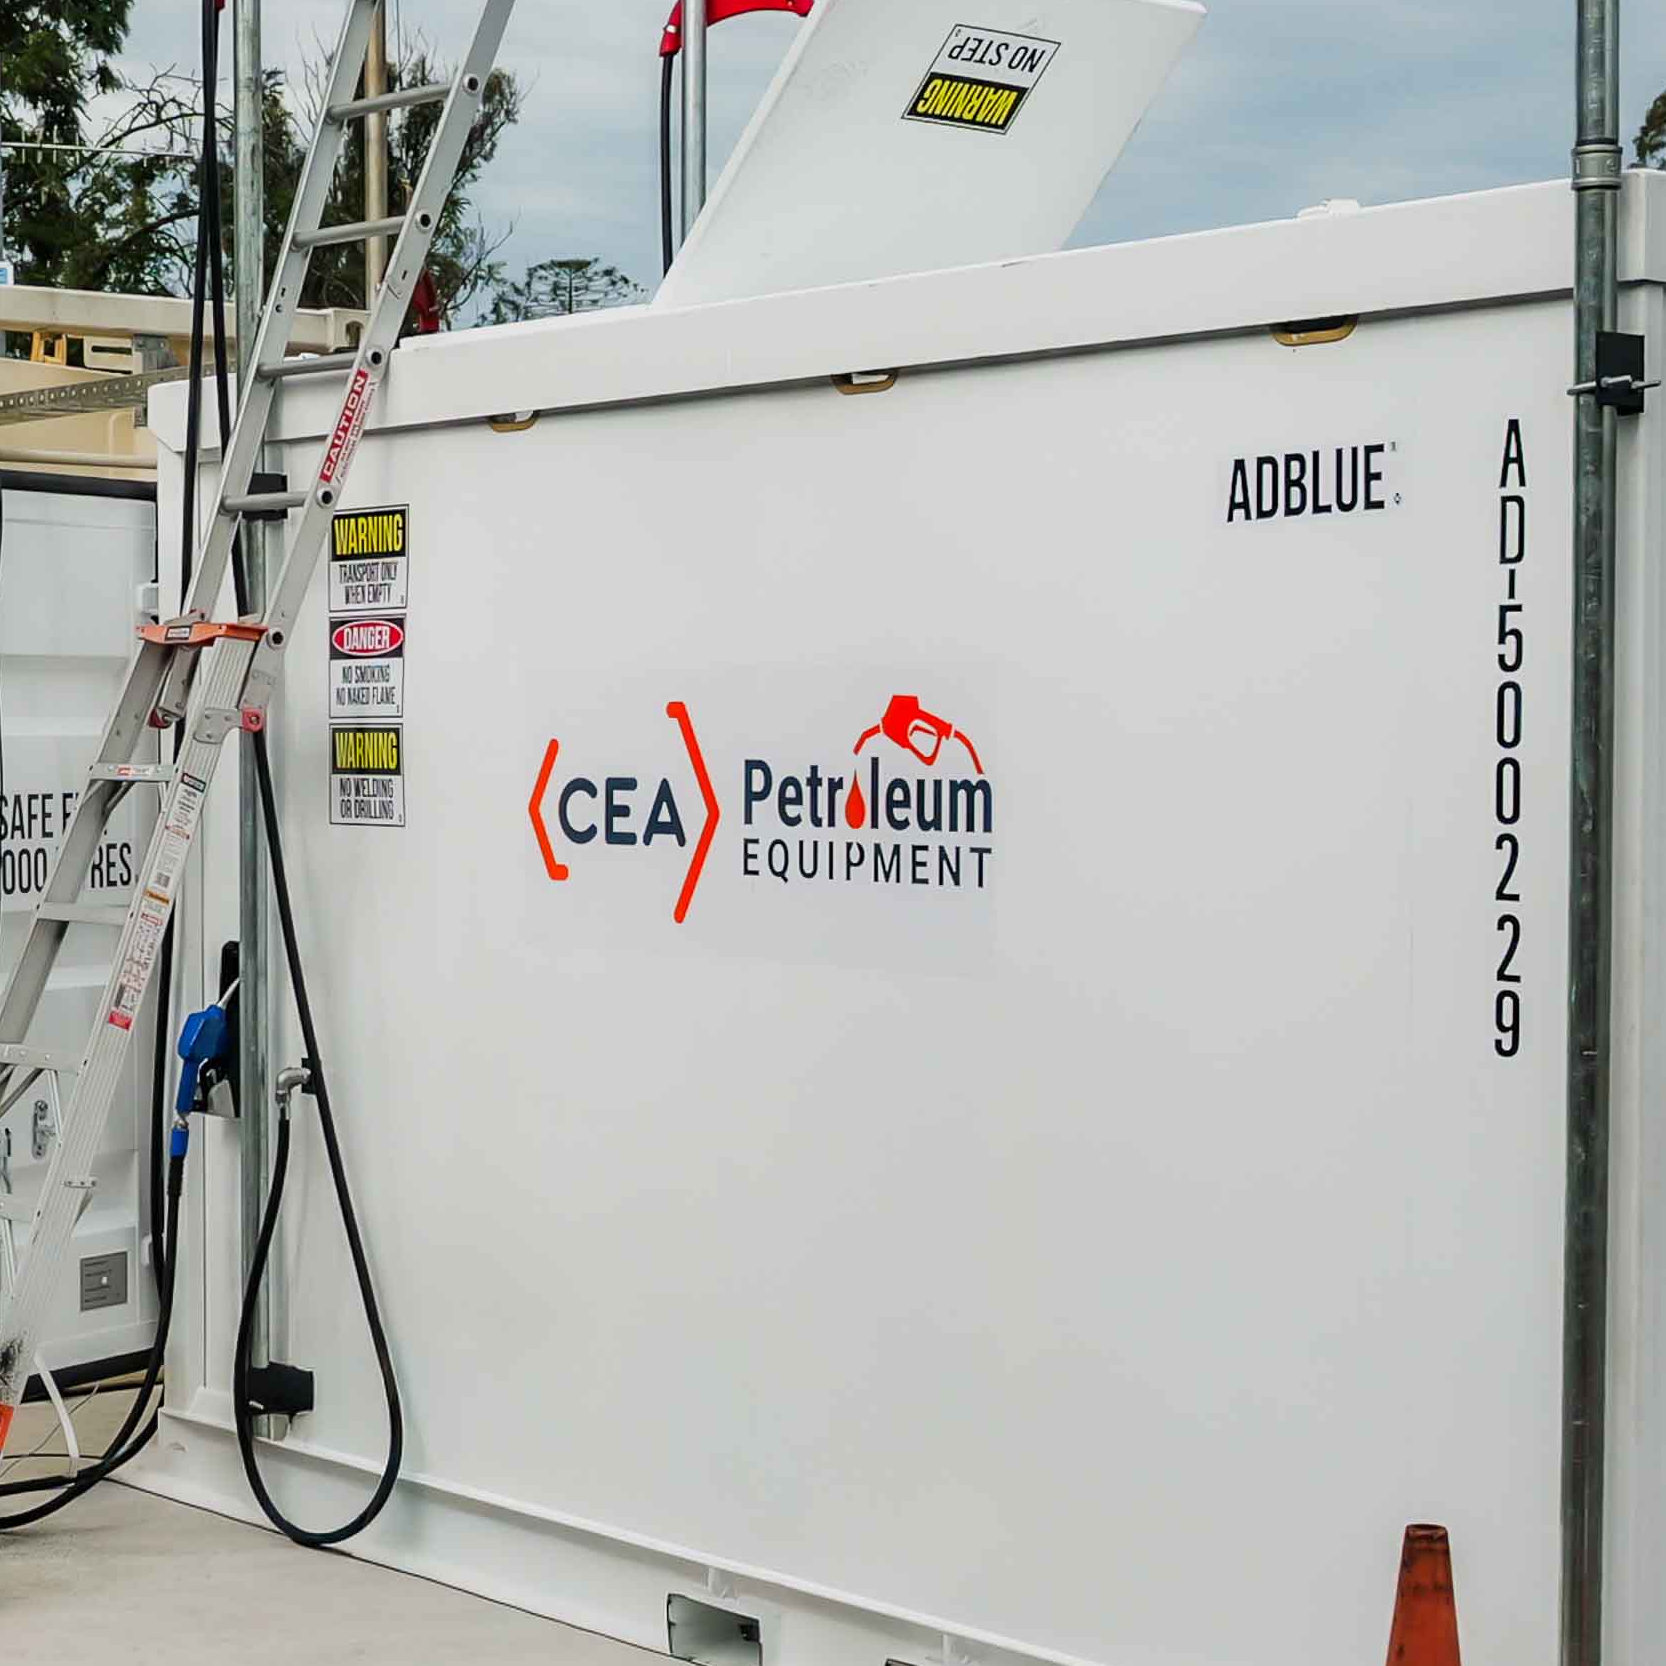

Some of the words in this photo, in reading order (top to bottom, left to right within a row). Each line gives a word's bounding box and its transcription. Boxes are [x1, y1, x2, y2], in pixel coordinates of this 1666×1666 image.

[948, 36, 1009, 66] STEP
[1008, 46, 1046, 73] NO
[916, 79, 1018, 125] WARNING
[323, 376, 367, 476] CAUTION
[1227, 443, 1385, 522] ADBLUE
[334, 514, 403, 555] WARNING
[339, 562, 380, 584] TRANSPORT
[381, 561, 398, 582] ONLY
[345, 584, 366, 605] WHEN
[367, 583, 392, 604] EMPTY
[343, 625, 390, 650] DANGER
[342, 665, 353, 684] NO
[354, 664, 390, 684] SMOKING
[336, 686, 346, 706] NO
[347, 686, 371, 706] NAKED
[372, 686, 396, 705] FLAME
[335, 731, 398, 770] WARNING
[340, 778, 353, 797] NO
[353, 778, 394, 798] WELDING
[743, 756, 993, 834] Petroleum
[340, 799, 353, 818] OR
[354, 799, 394, 820] DRILLING
[743, 838, 993, 888] EQUIPMENT
